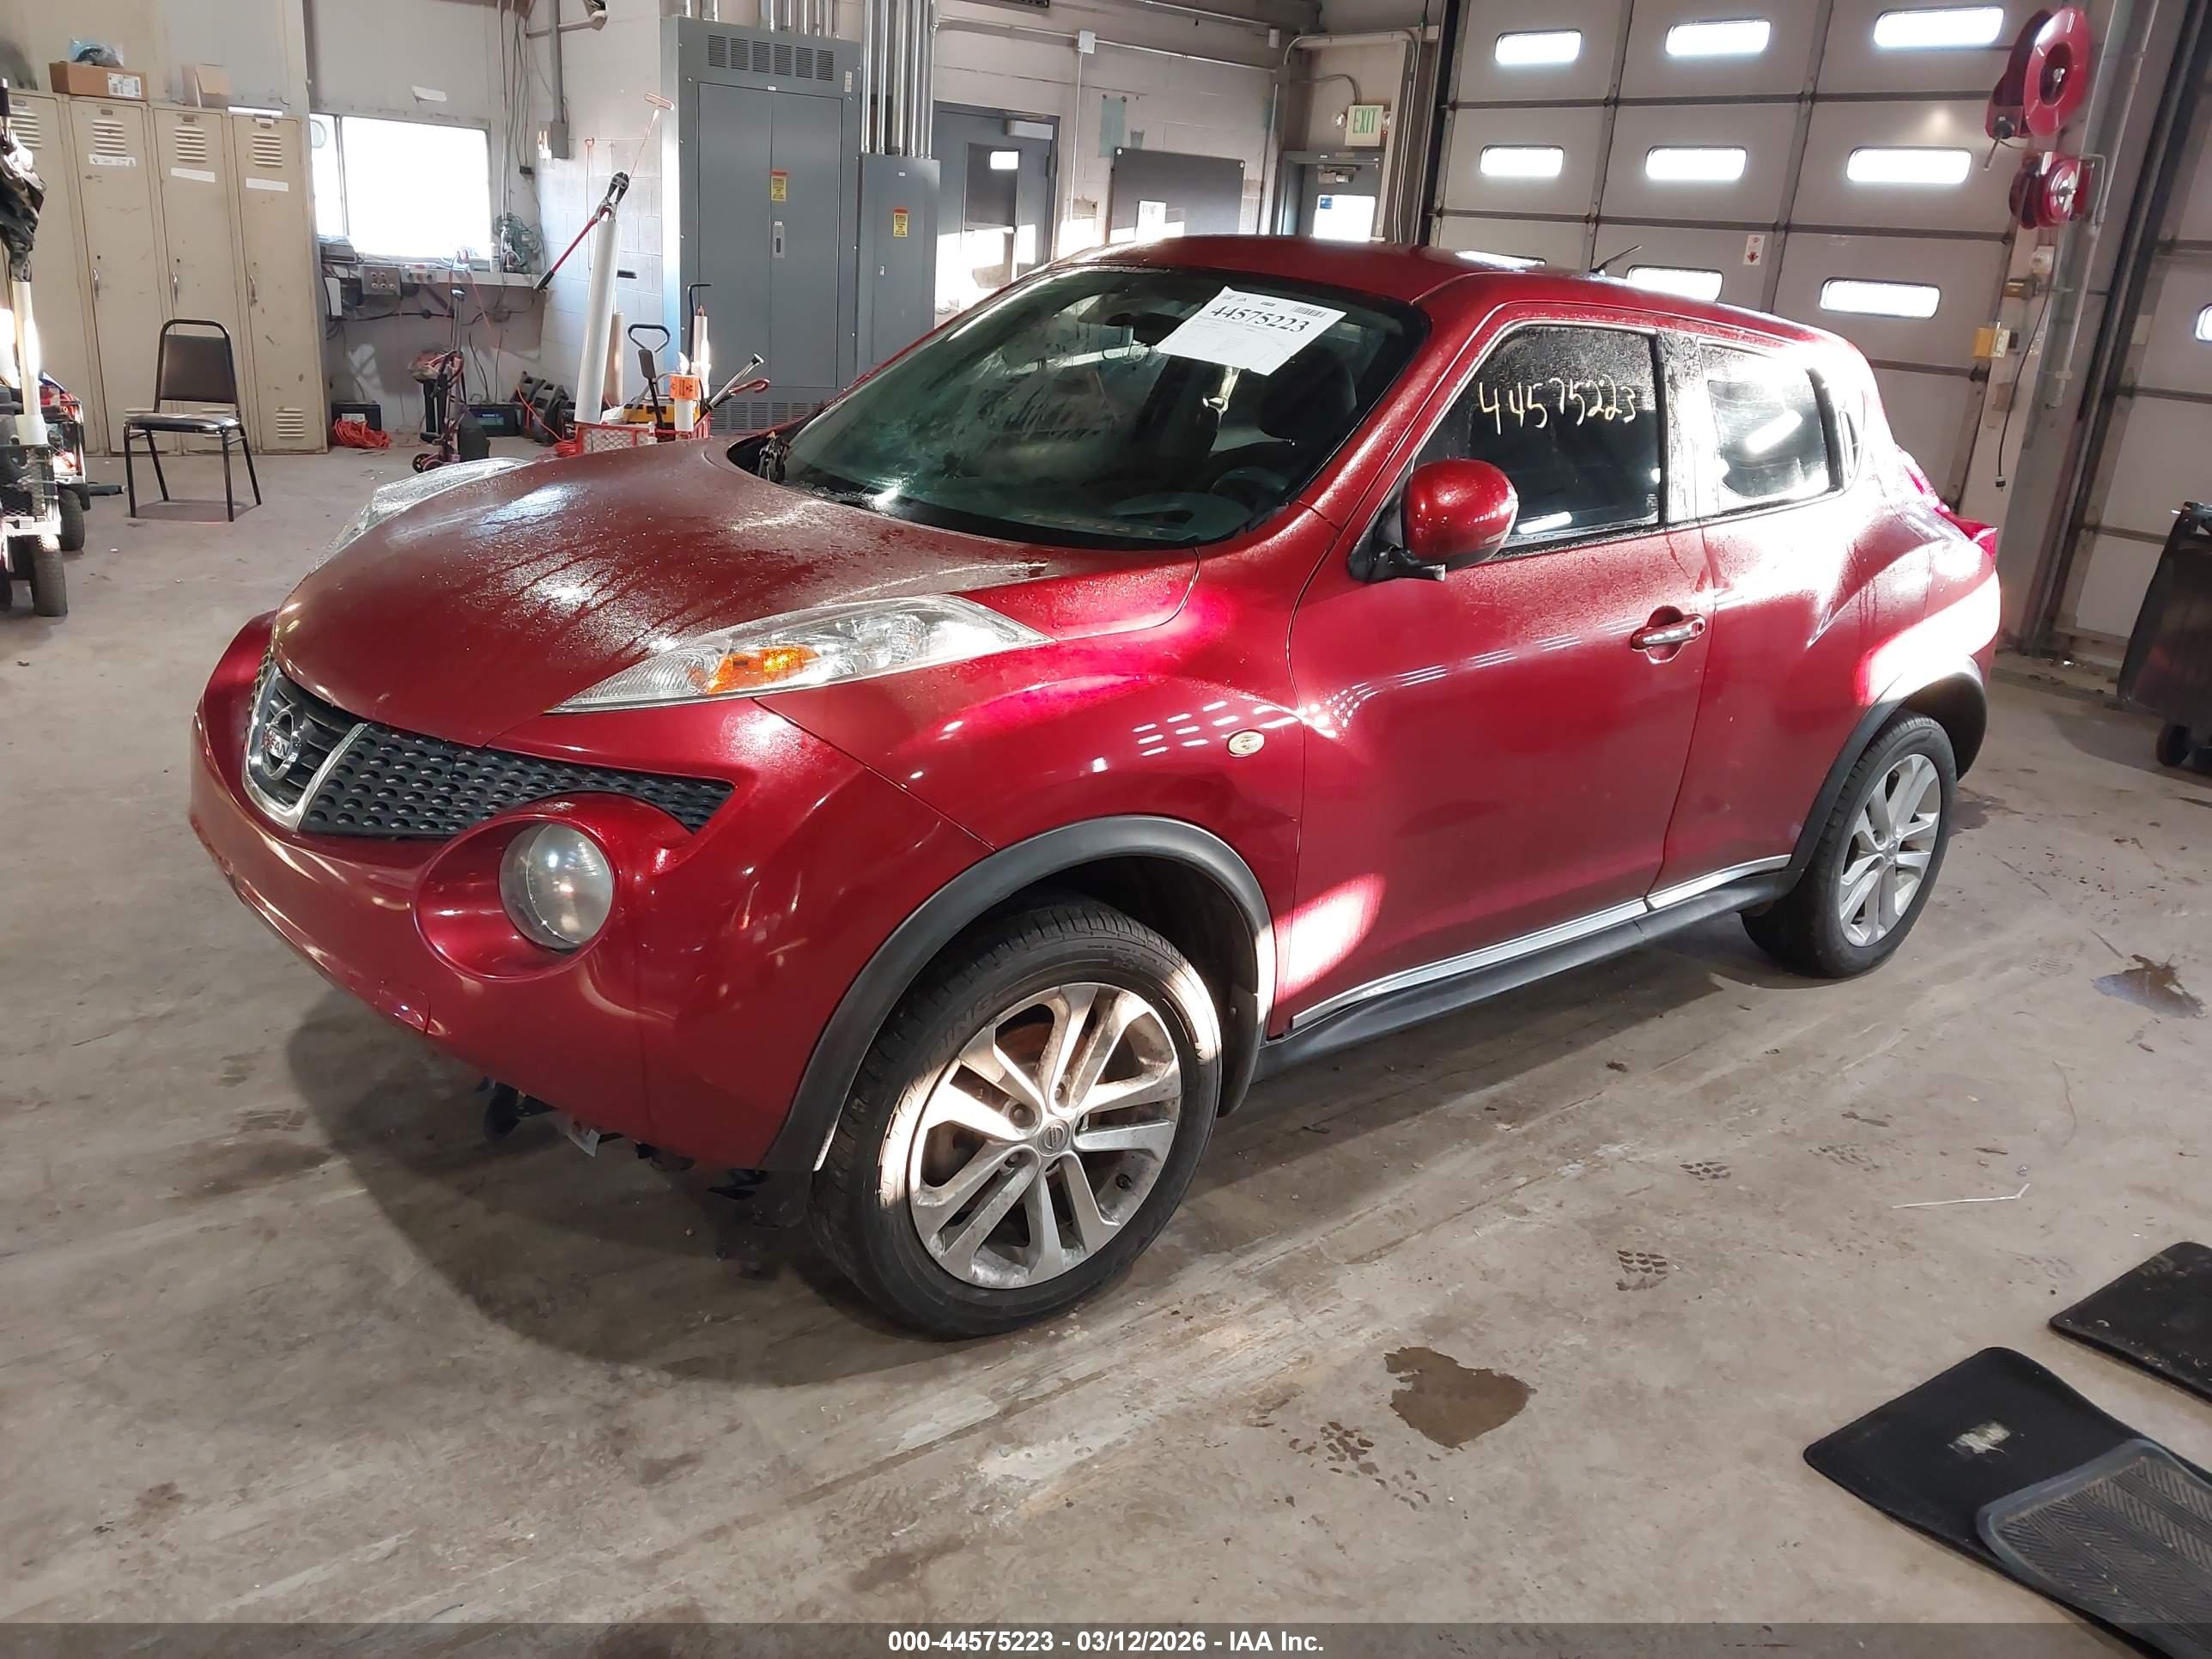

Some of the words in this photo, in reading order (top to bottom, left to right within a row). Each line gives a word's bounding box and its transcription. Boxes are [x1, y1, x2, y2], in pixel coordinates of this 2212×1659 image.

[1352, 108, 1380, 134] EXIT
[1211, 305, 1310, 333] 44575223
[1479, 374, 1637, 435] 44575223
